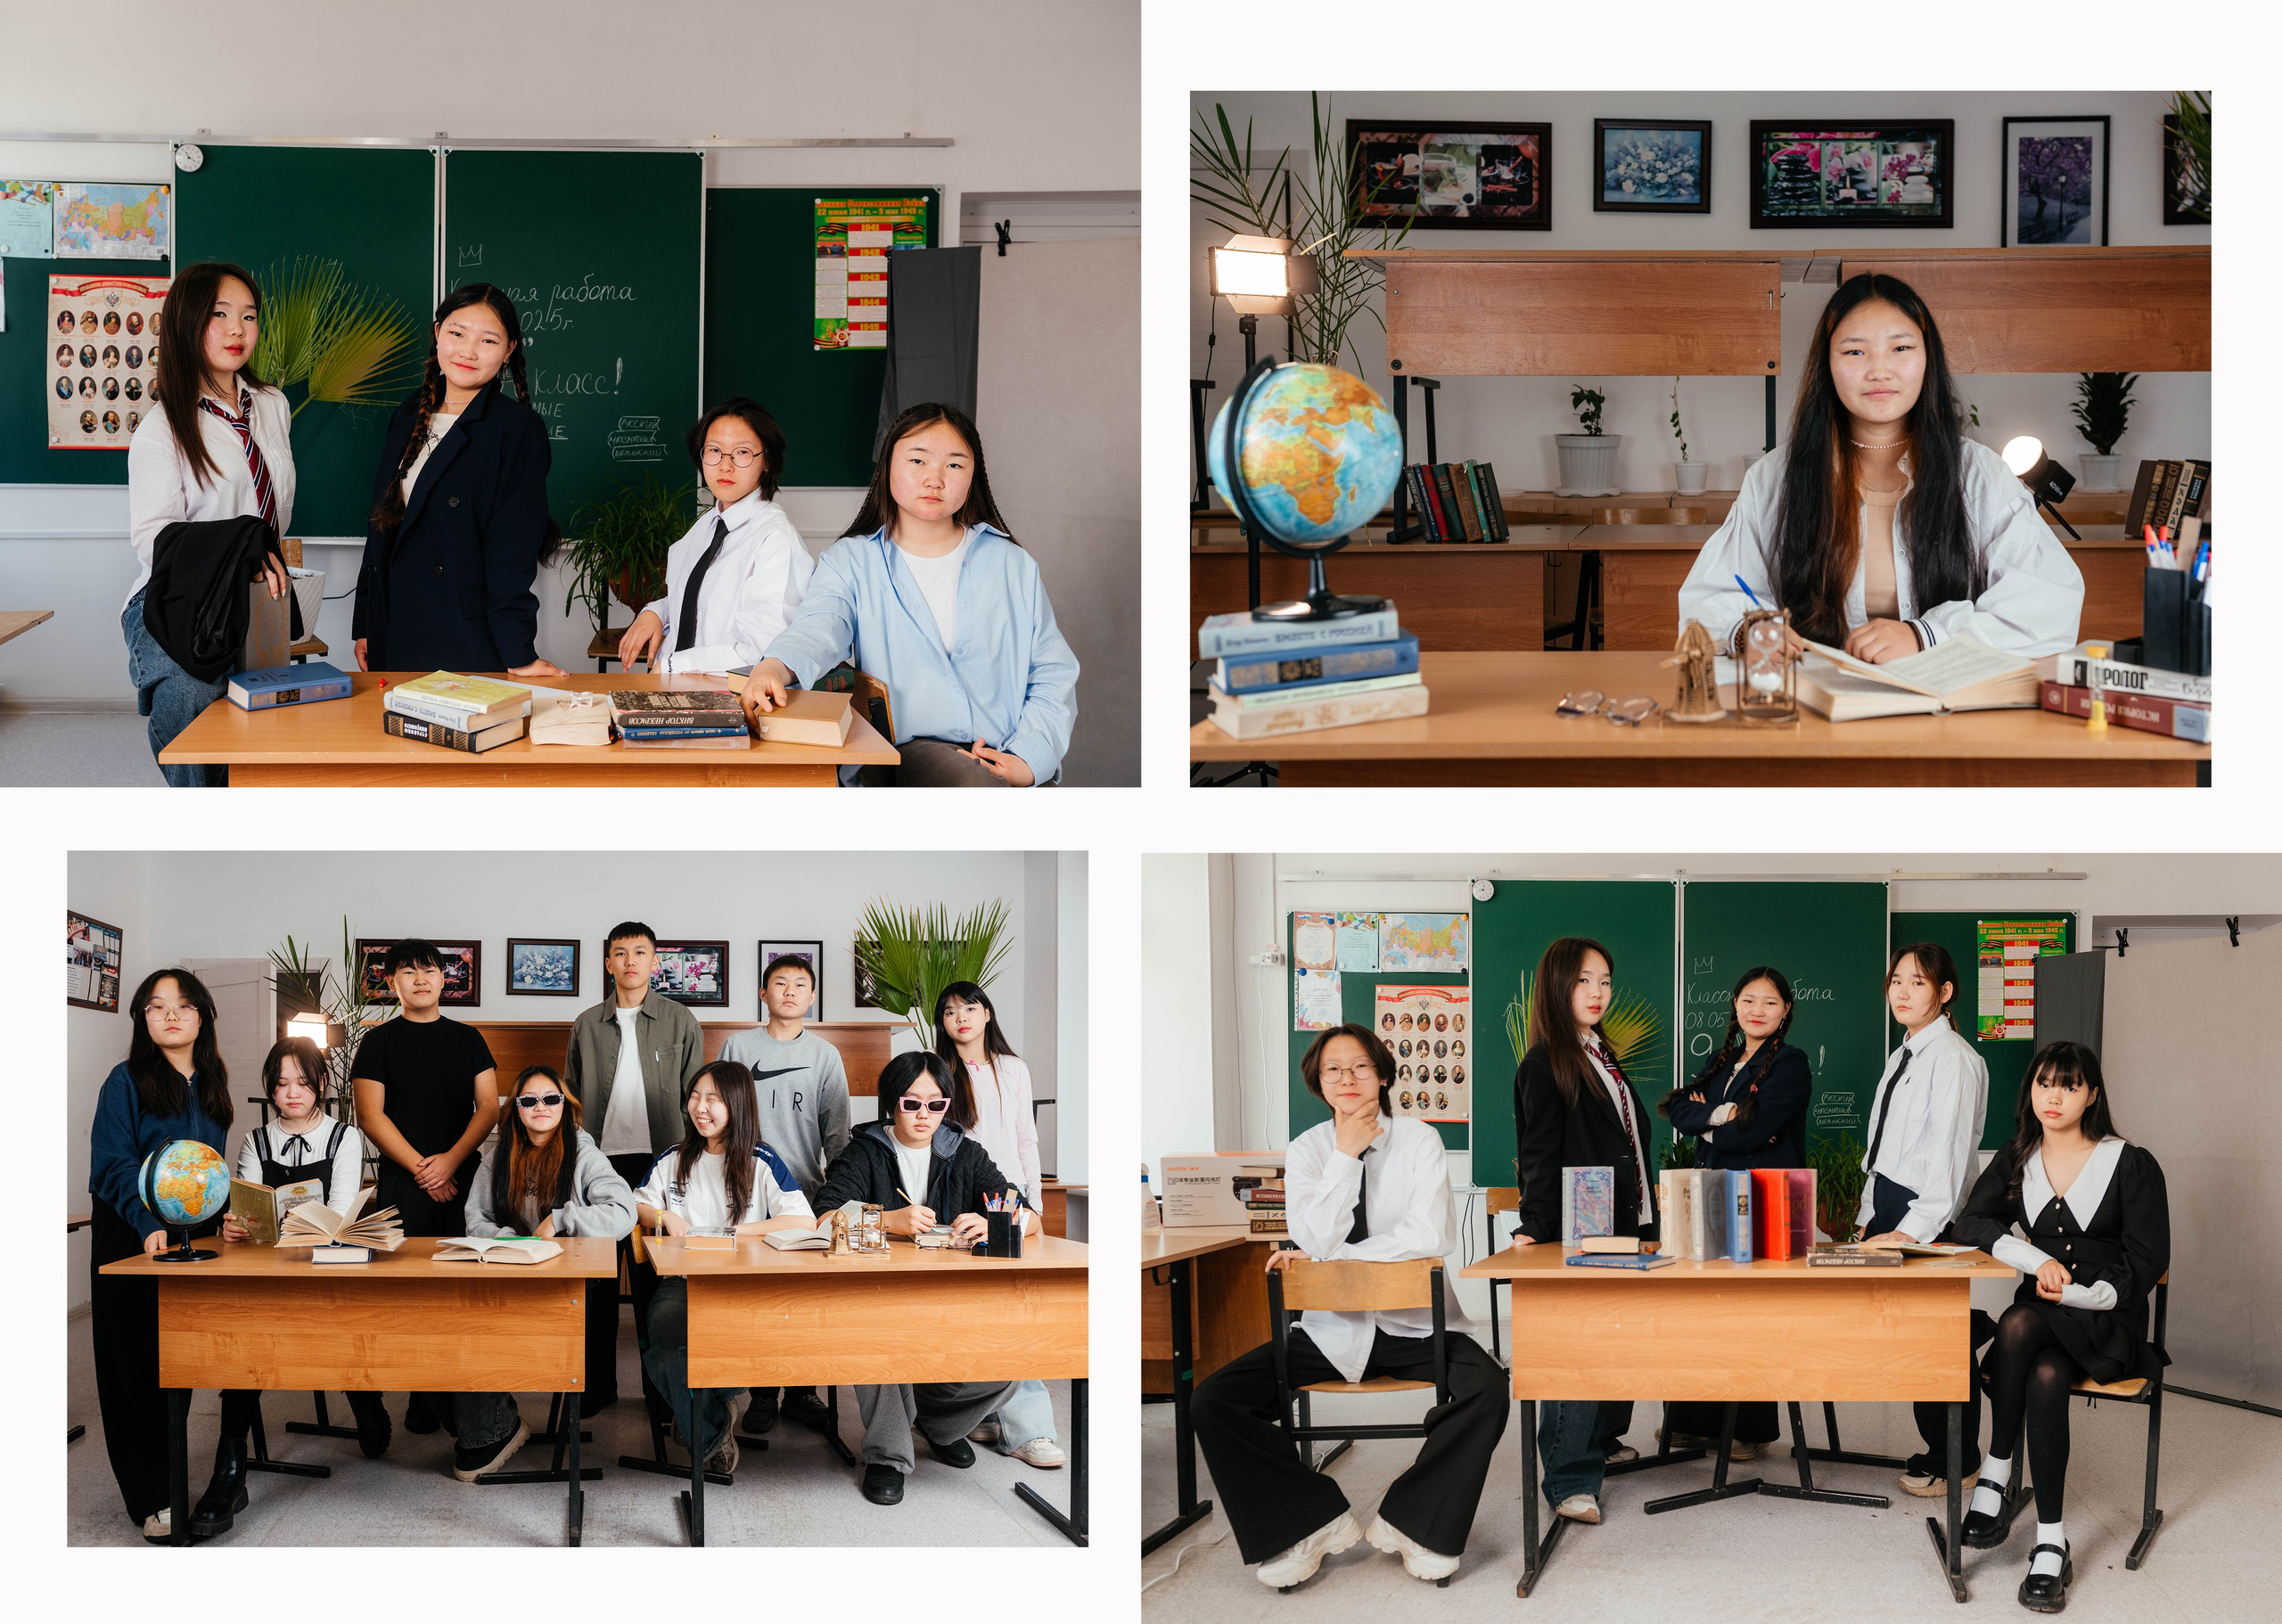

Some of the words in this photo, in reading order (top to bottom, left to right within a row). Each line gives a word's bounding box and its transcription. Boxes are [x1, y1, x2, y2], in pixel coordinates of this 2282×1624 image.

[847, 200, 902, 208] Отечественная
[859, 249, 881, 257] 1942
[859, 273, 881, 282] 1943
[546, 273, 636, 323] работа
[859, 298, 880, 307] 1944
[859, 323, 880, 331] 1945
[535, 357, 623, 396] класс!
[621, 418, 658, 430] РУССКИЙ
[2116, 704, 2160, 723] ИСТОРИЯ
[628, 717, 665, 726] НЕКРАСОВ
[665, 717, 694, 725] ВИКТОР
[404, 726, 428, 738] СТРАНИЦЫ
[1790, 979, 1836, 1001] бота
[1824, 1094, 1854, 1103] РУССКИЙ
